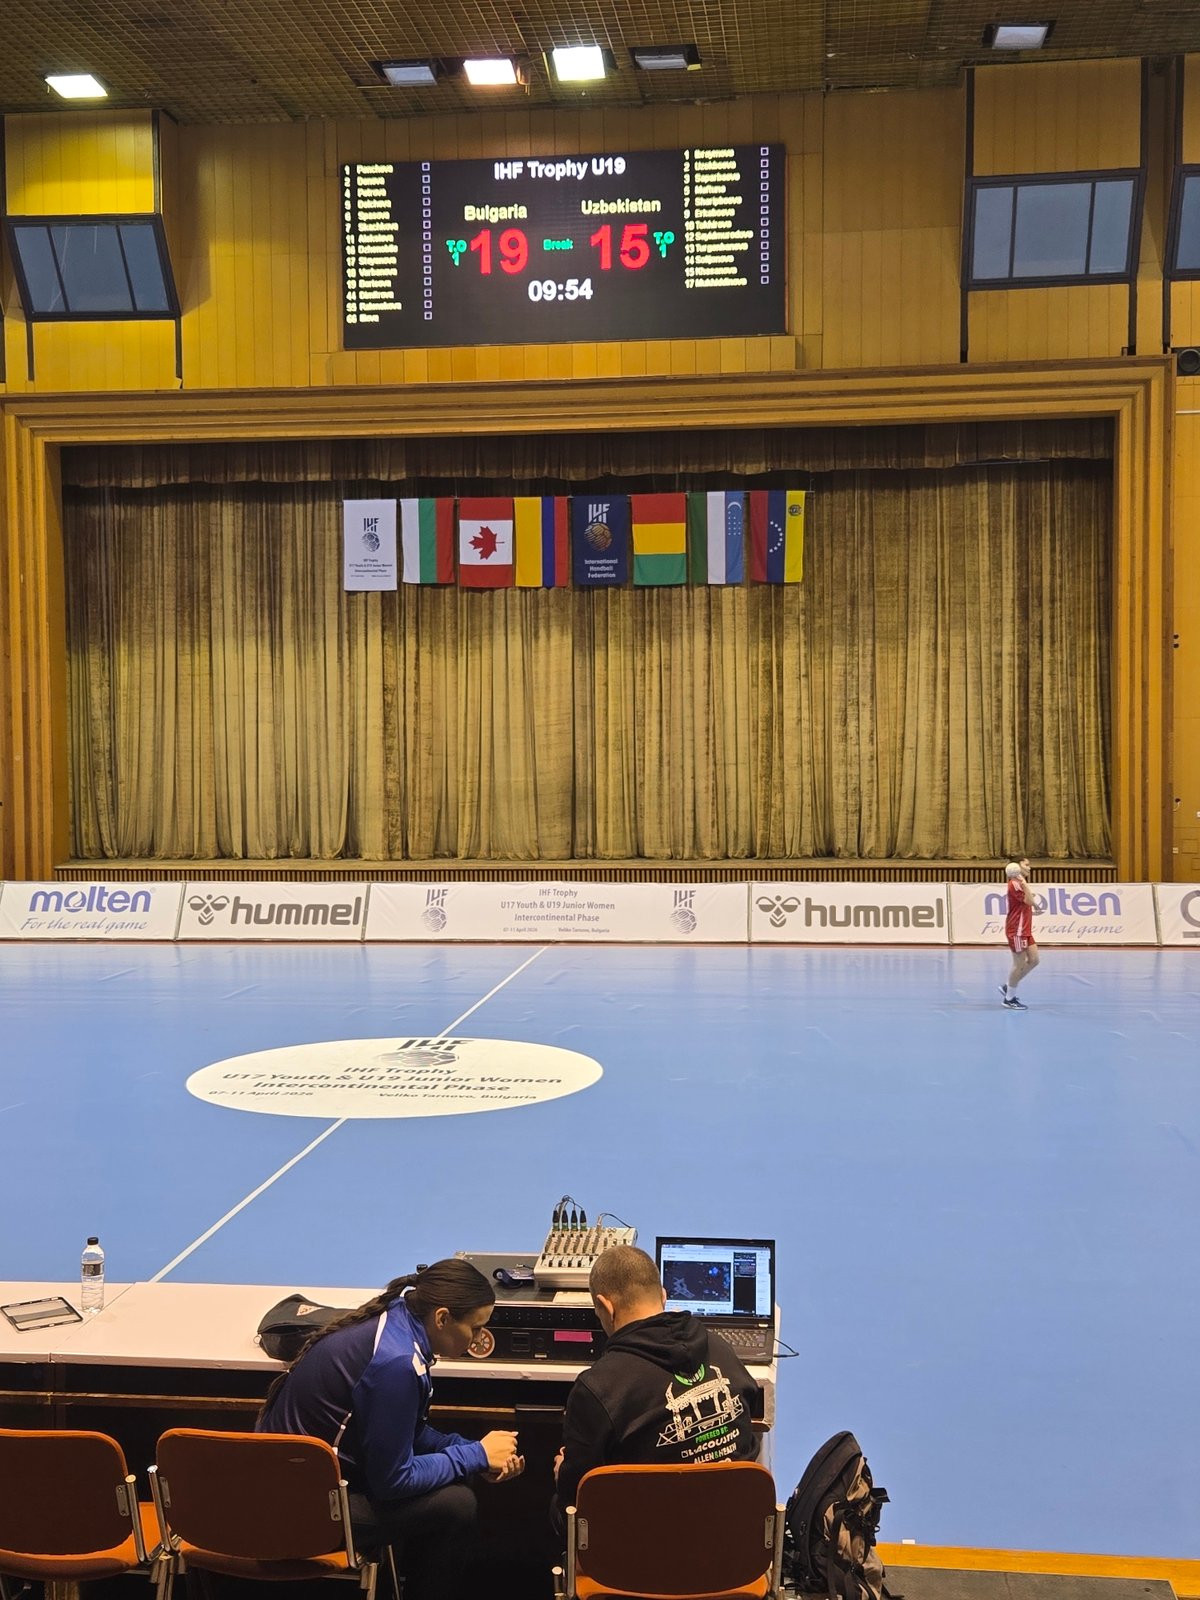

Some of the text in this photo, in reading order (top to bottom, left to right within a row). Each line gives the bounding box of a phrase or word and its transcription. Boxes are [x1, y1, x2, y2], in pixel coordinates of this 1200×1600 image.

[683, 150, 690, 160] 1
[344, 165, 350, 176] 1
[494, 157, 627, 181] IHF Trophy U19
[683, 162, 691, 172] 2
[344, 177, 351, 187] 2
[683, 174, 691, 184] 3
[344, 189, 351, 198] 4
[581, 198, 662, 215] Uzbekistan
[683, 197, 691, 207] 7
[464, 204, 528, 223] Bulgaria
[345, 223, 352, 233] 7
[346, 235, 355, 244] 11
[684, 232, 695, 242] 12
[543, 238, 573, 251] Break
[590, 223, 651, 271] 15
[684, 244, 695, 254] 13
[470, 228, 529, 276] 19
[346, 257, 357, 266] 17
[684, 255, 695, 265] 14
[684, 267, 695, 277] 15
[684, 278, 695, 288] 17
[528, 278, 593, 302] 09:54
[588, 503, 611, 524] IHF
[363, 517, 379, 532] IHF
[426, 888, 449, 907] IHF
[539, 888, 578, 898] IHF Trophy
[29, 886, 152, 913] molten
[674, 890, 697, 909] IHF
[500, 900, 615, 910] U17 Youth & U19 Junior Women
[230, 896, 362, 925] hummel
[804, 897, 944, 928] hummel
[514, 913, 600, 922] Intercontinental Phase
[21, 917, 149, 934] For the real game
[1039, 921, 1073, 934] real
[1075, 924, 1122, 939] game
[397, 1039, 474, 1050] IHF
[253, 1082, 439, 1090] Intercontinental
